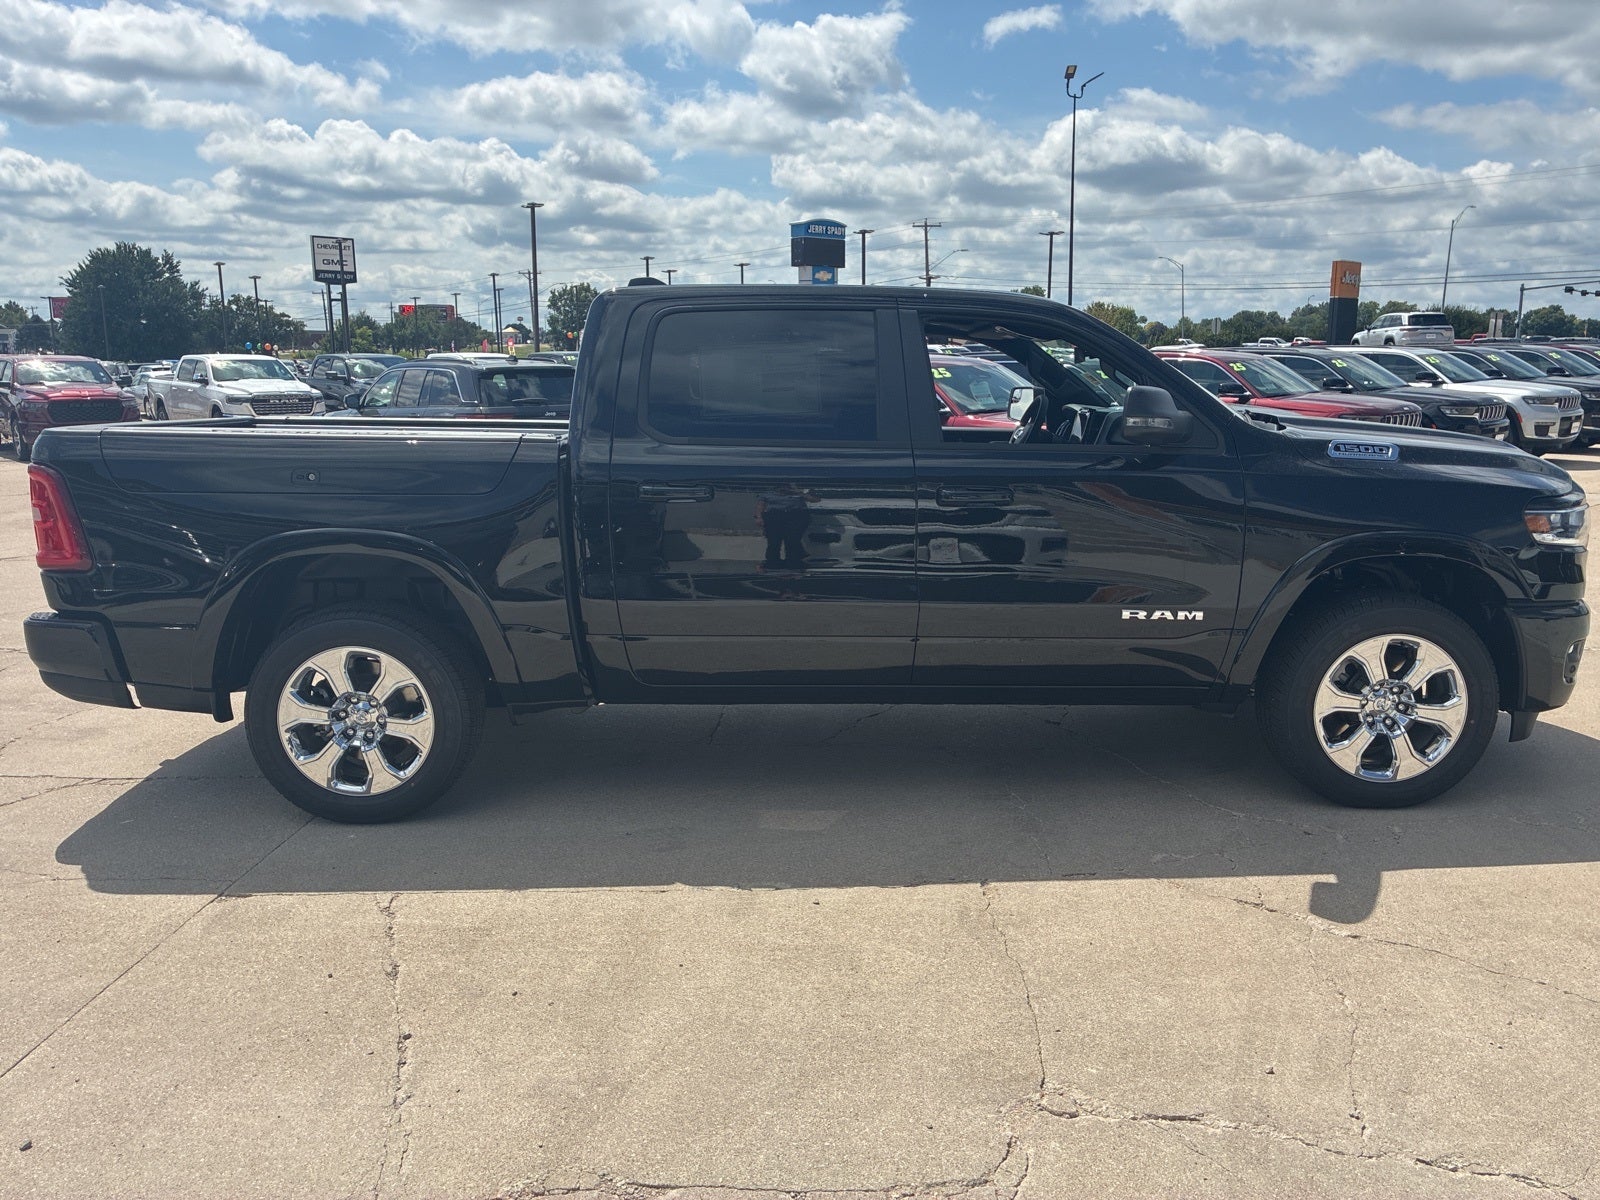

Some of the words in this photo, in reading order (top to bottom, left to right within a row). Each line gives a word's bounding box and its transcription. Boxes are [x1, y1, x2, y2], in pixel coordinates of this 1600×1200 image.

[808, 224, 826, 233] JERRY
[827, 225, 845, 235] SPADY
[322, 258, 348, 266] GMC
[1229, 362, 1247, 372] 25
[931, 367, 952, 379] 25
[1336, 443, 1389, 454] 1500
[1121, 609, 1204, 621] RAM
